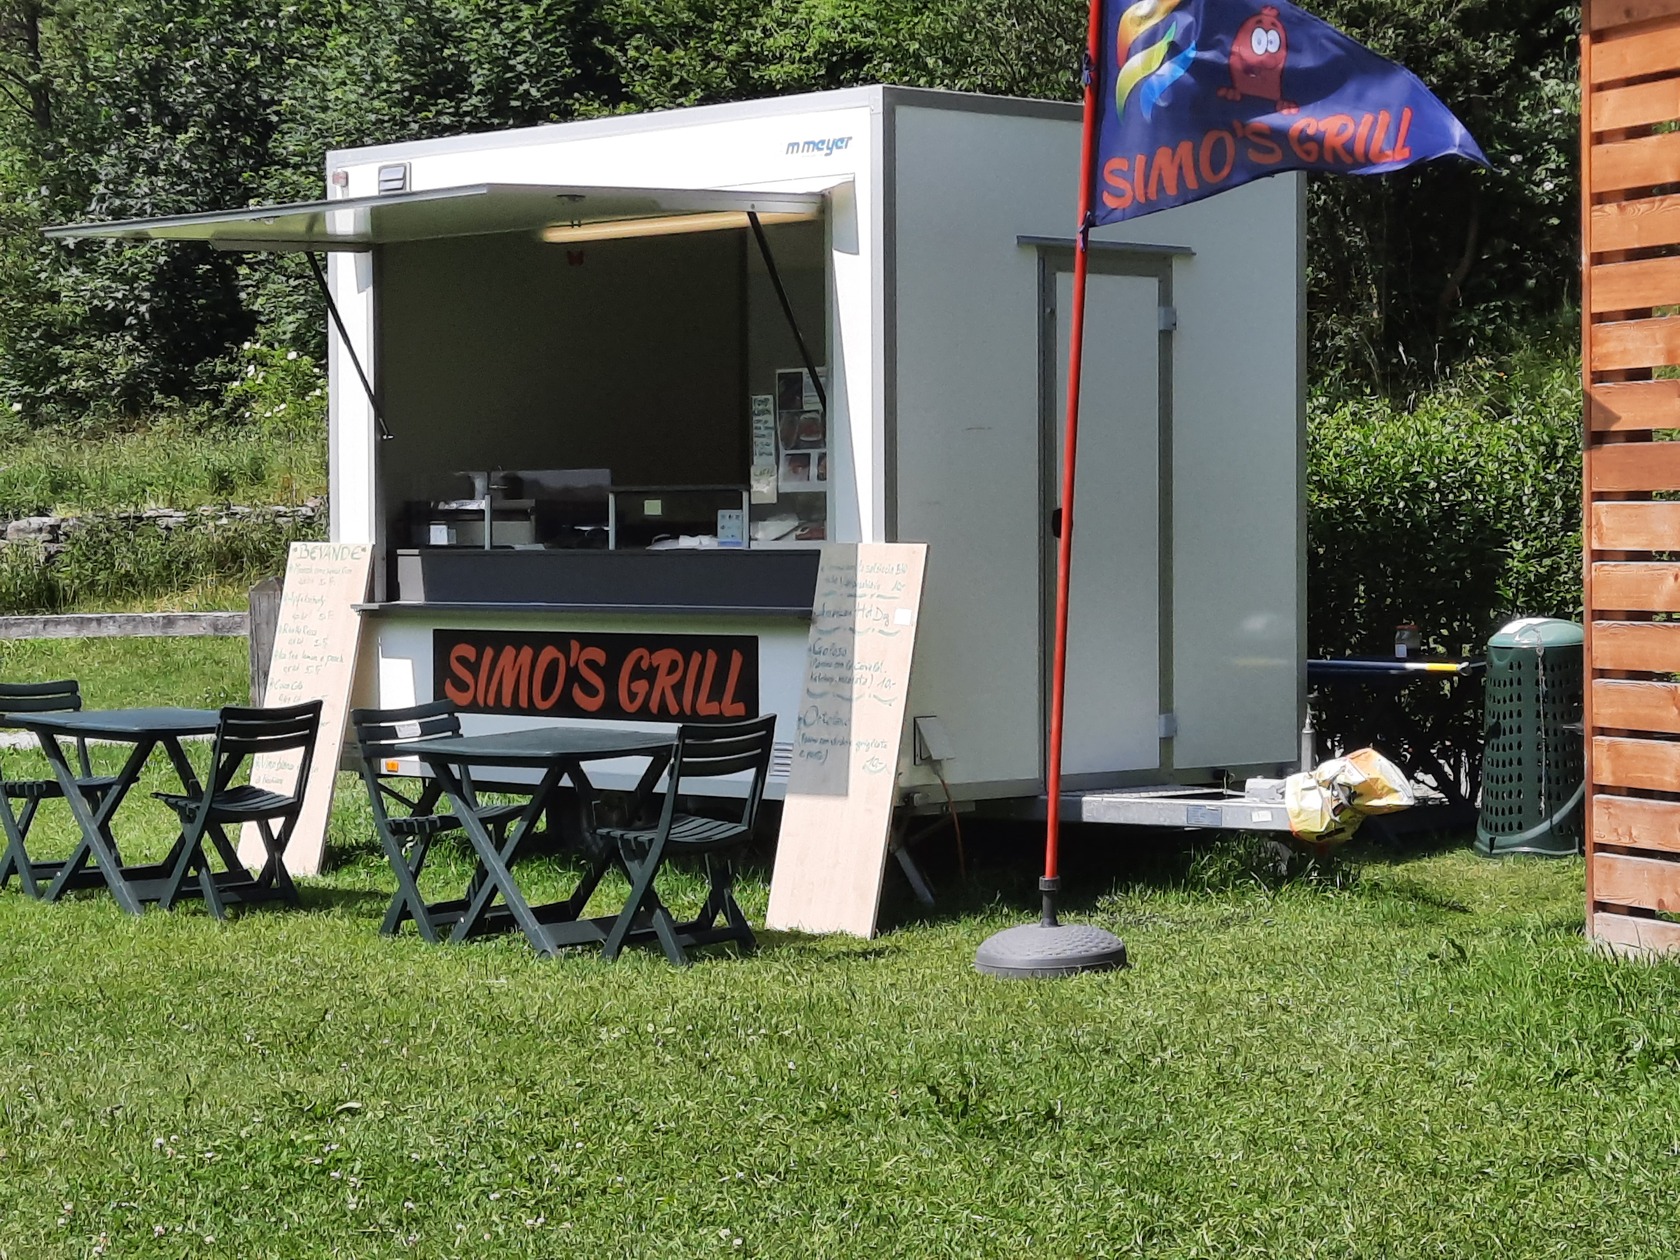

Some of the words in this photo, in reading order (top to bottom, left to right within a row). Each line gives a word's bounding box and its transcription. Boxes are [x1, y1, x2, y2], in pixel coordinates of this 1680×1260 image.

[1102, 120, 1283, 209] SIMO'S
[1289, 106, 1413, 164] GRILL
[297, 543, 362, 561] BEVANDE
[445, 639, 607, 712] SIMO'S
[618, 647, 746, 717] GRILL
